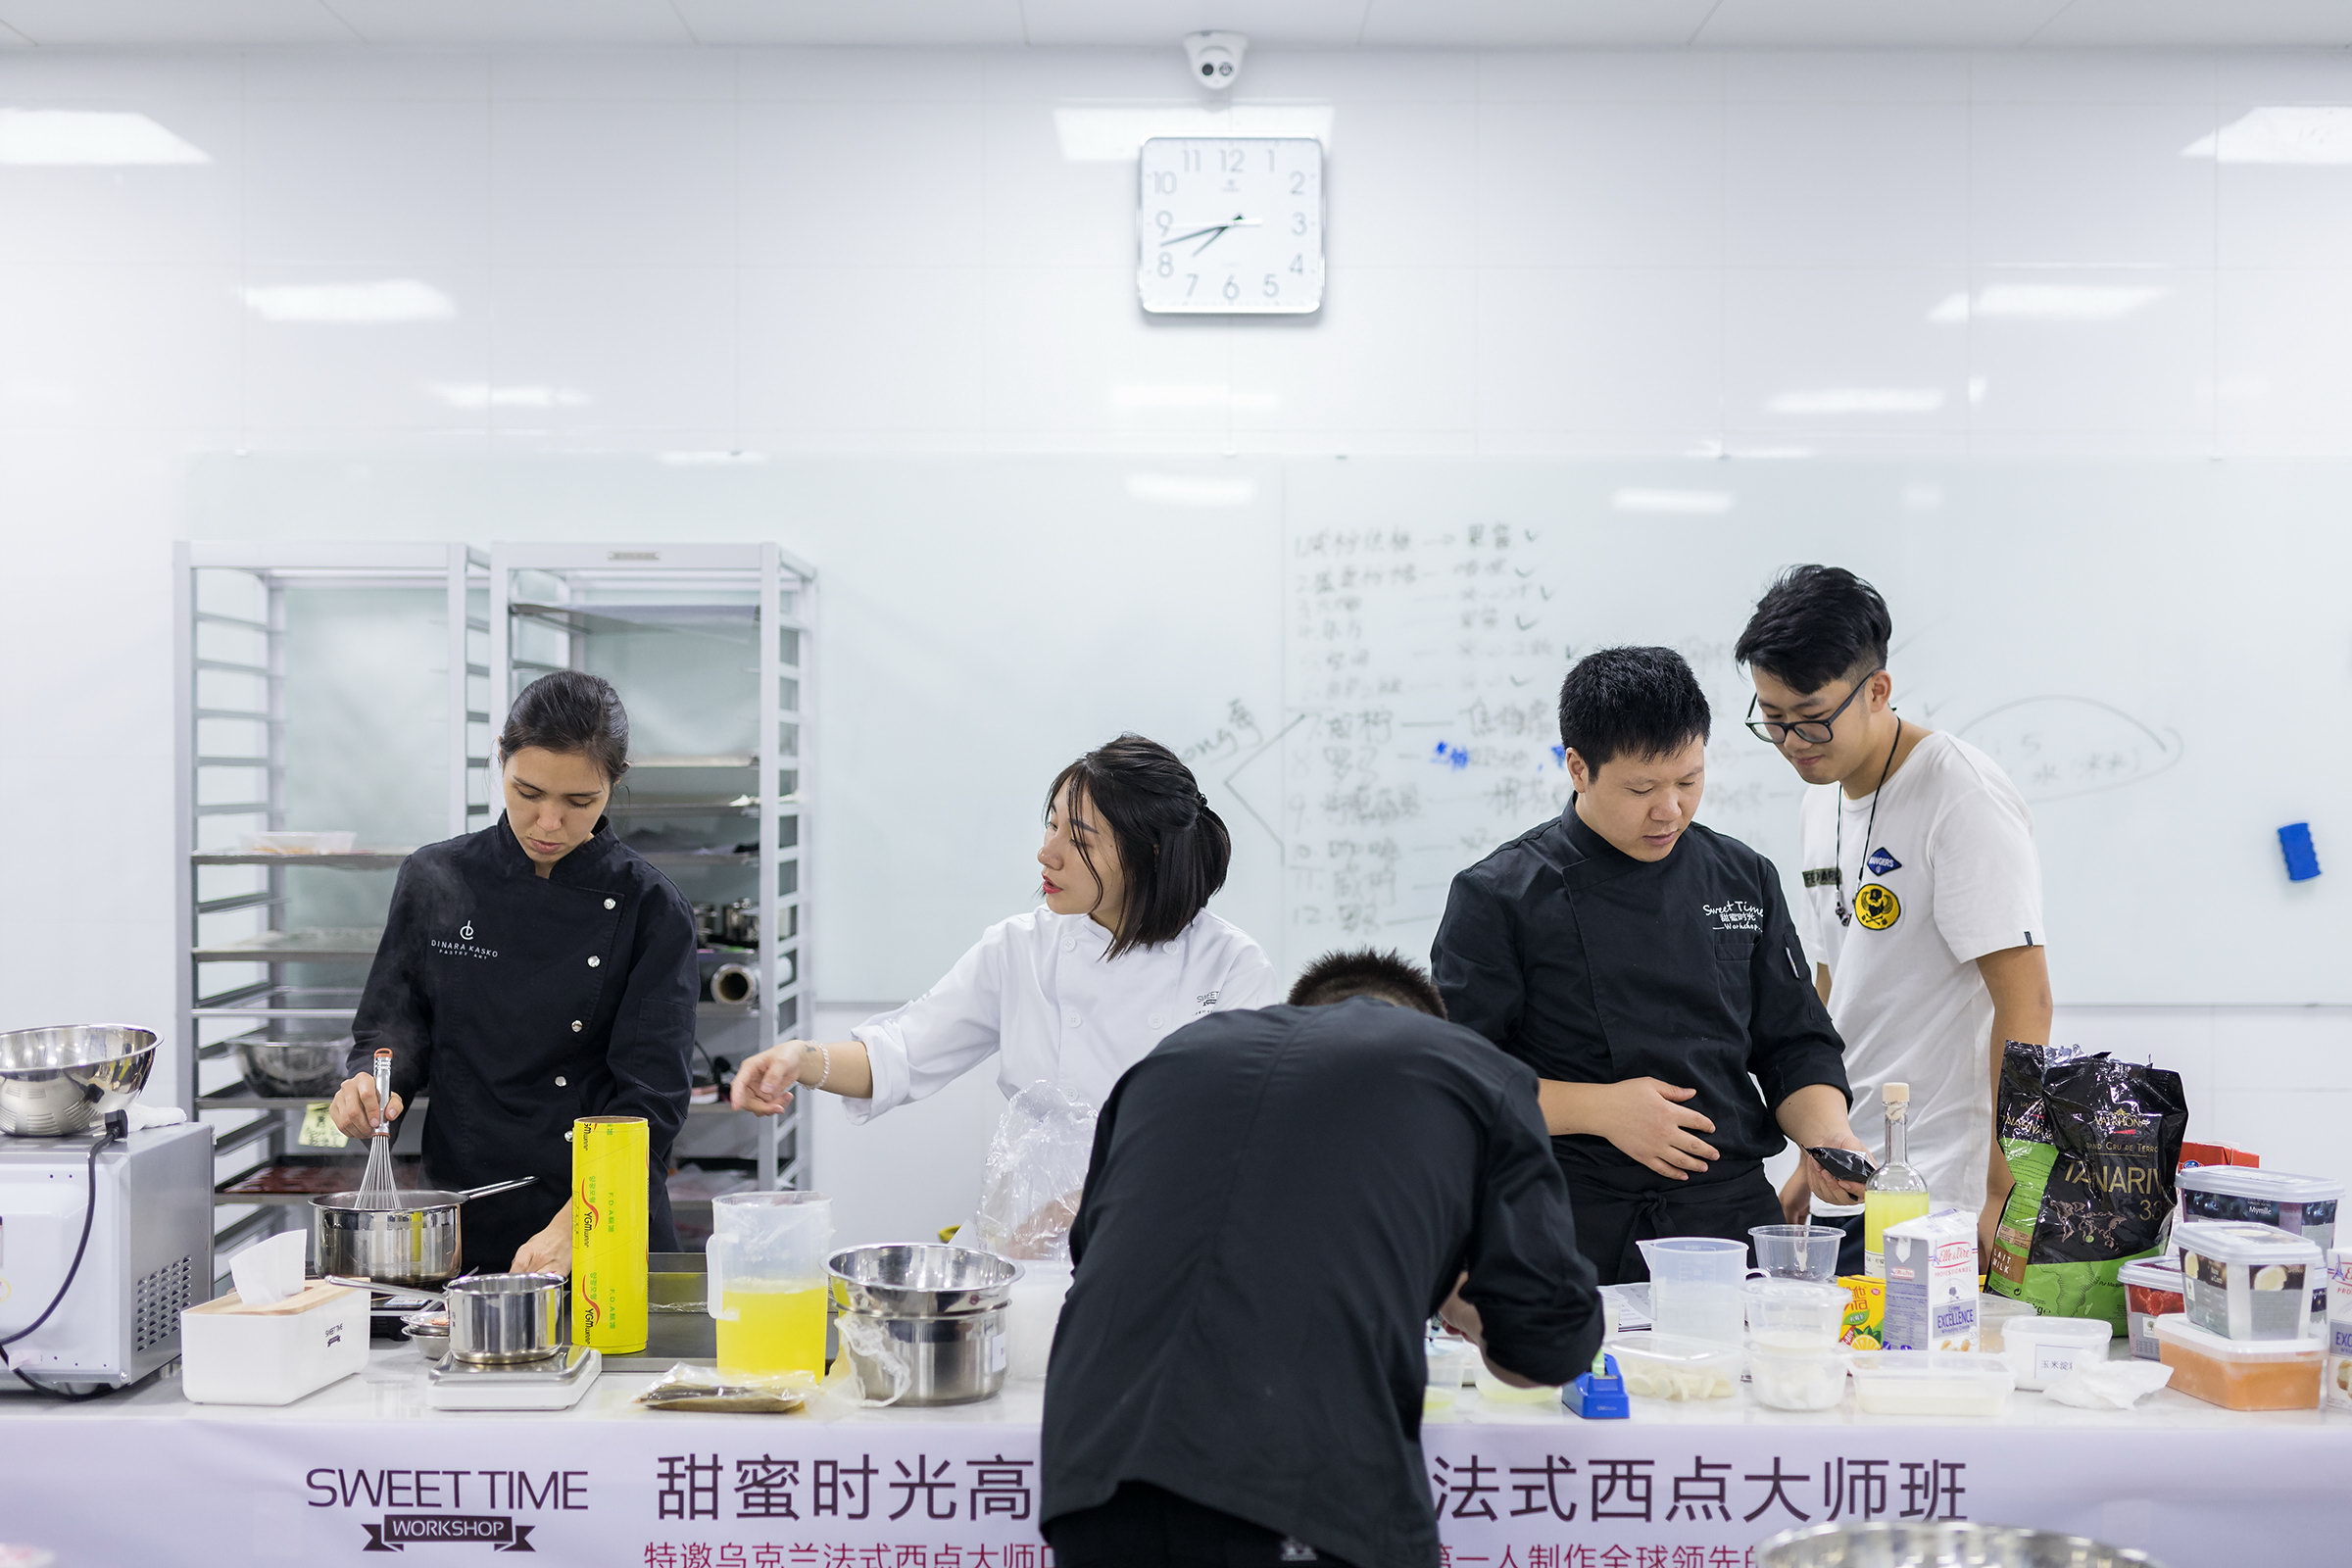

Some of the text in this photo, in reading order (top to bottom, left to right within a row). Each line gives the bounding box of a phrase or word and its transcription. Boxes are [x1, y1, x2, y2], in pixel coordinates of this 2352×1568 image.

[1181, 148, 1201, 173] 11
[1219, 148, 1246, 173] 12
[1265, 148, 1276, 173] 1
[1152, 171, 1177, 195] 10
[1289, 170, 1305, 195] 2
[1154, 210, 1174, 237] 9
[1291, 211, 1307, 236] 3
[1156, 251, 1175, 278] 8
[1288, 252, 1304, 275] 4
[1184, 272, 1199, 297] 7
[1223, 273, 1241, 301] 6
[1262, 273, 1280, 298] 5
[1702, 900, 1764, 918] Sweet Time
[430, 939, 499, 957] DINARA KASKO
[1991, 1257, 2010, 1274] MILK
[1993, 1249, 2012, 1264] LAIT
[1936, 1308, 1974, 1329] EXCELLENCE
[306, 1468, 589, 1510] SWEET TIME
[657, 1453, 1968, 1523] 甜蜜时光高 法式西点大师班
[392, 1519, 505, 1538] WORKSHOP
